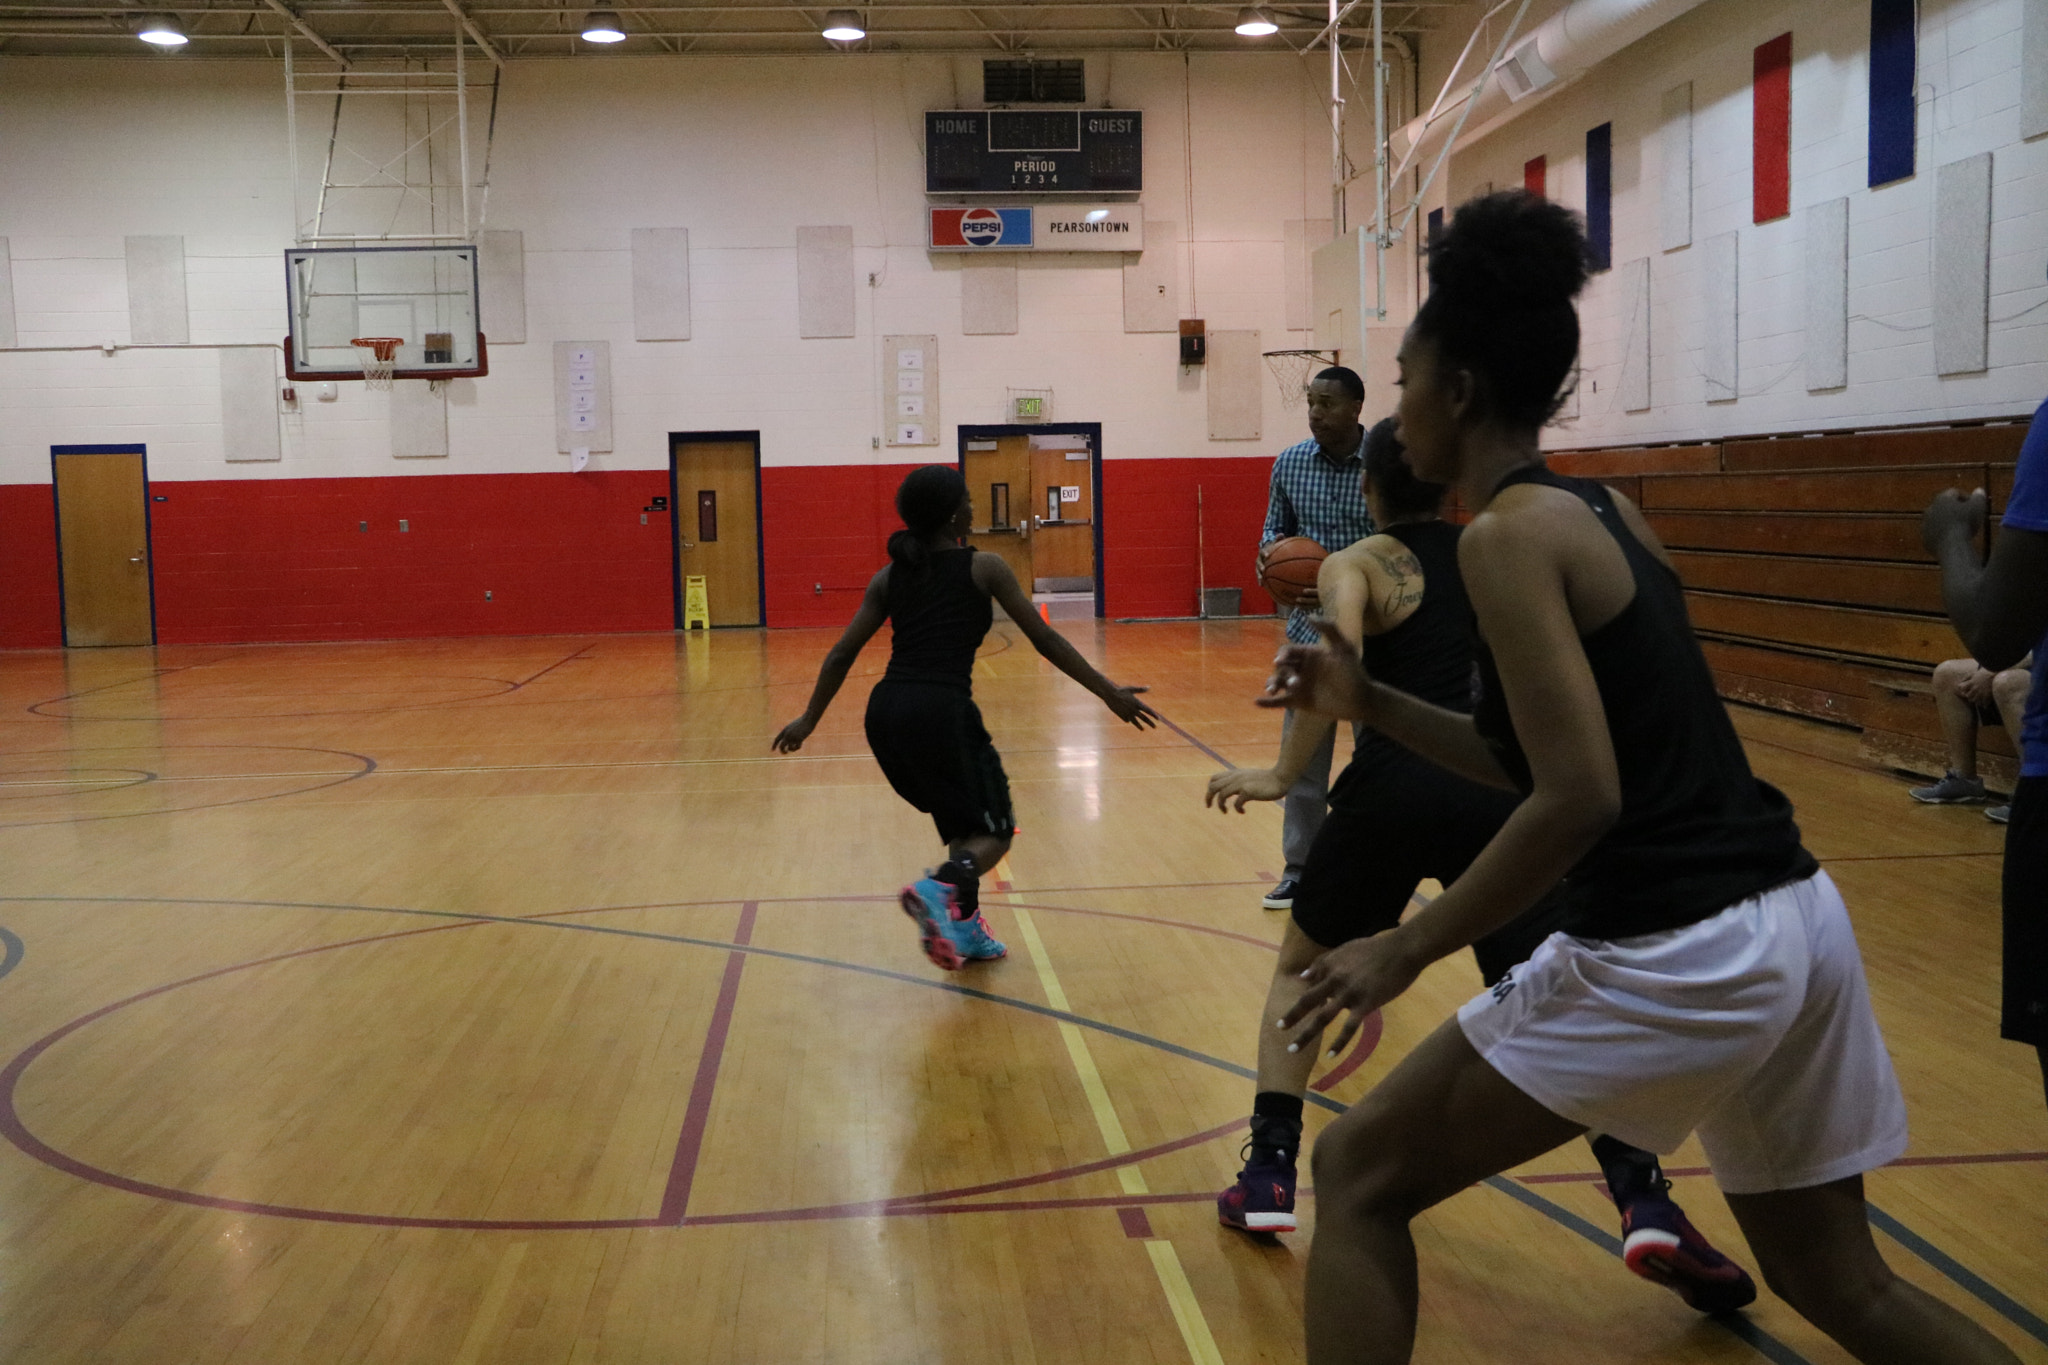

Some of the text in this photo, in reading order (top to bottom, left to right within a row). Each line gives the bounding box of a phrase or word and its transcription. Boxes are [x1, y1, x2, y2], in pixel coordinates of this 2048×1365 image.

[935, 119, 977, 134] HOME
[1088, 118, 1133, 133] GUEST
[1014, 161, 1056, 172] PERIOD
[1011, 174, 1058, 184] 1 2 3 4
[962, 222, 1001, 233] PEPSI
[1050, 222, 1129, 233] PEARSONTOWN
[1019, 400, 1041, 414] EXIT
[1062, 490, 1078, 499] EXIT
